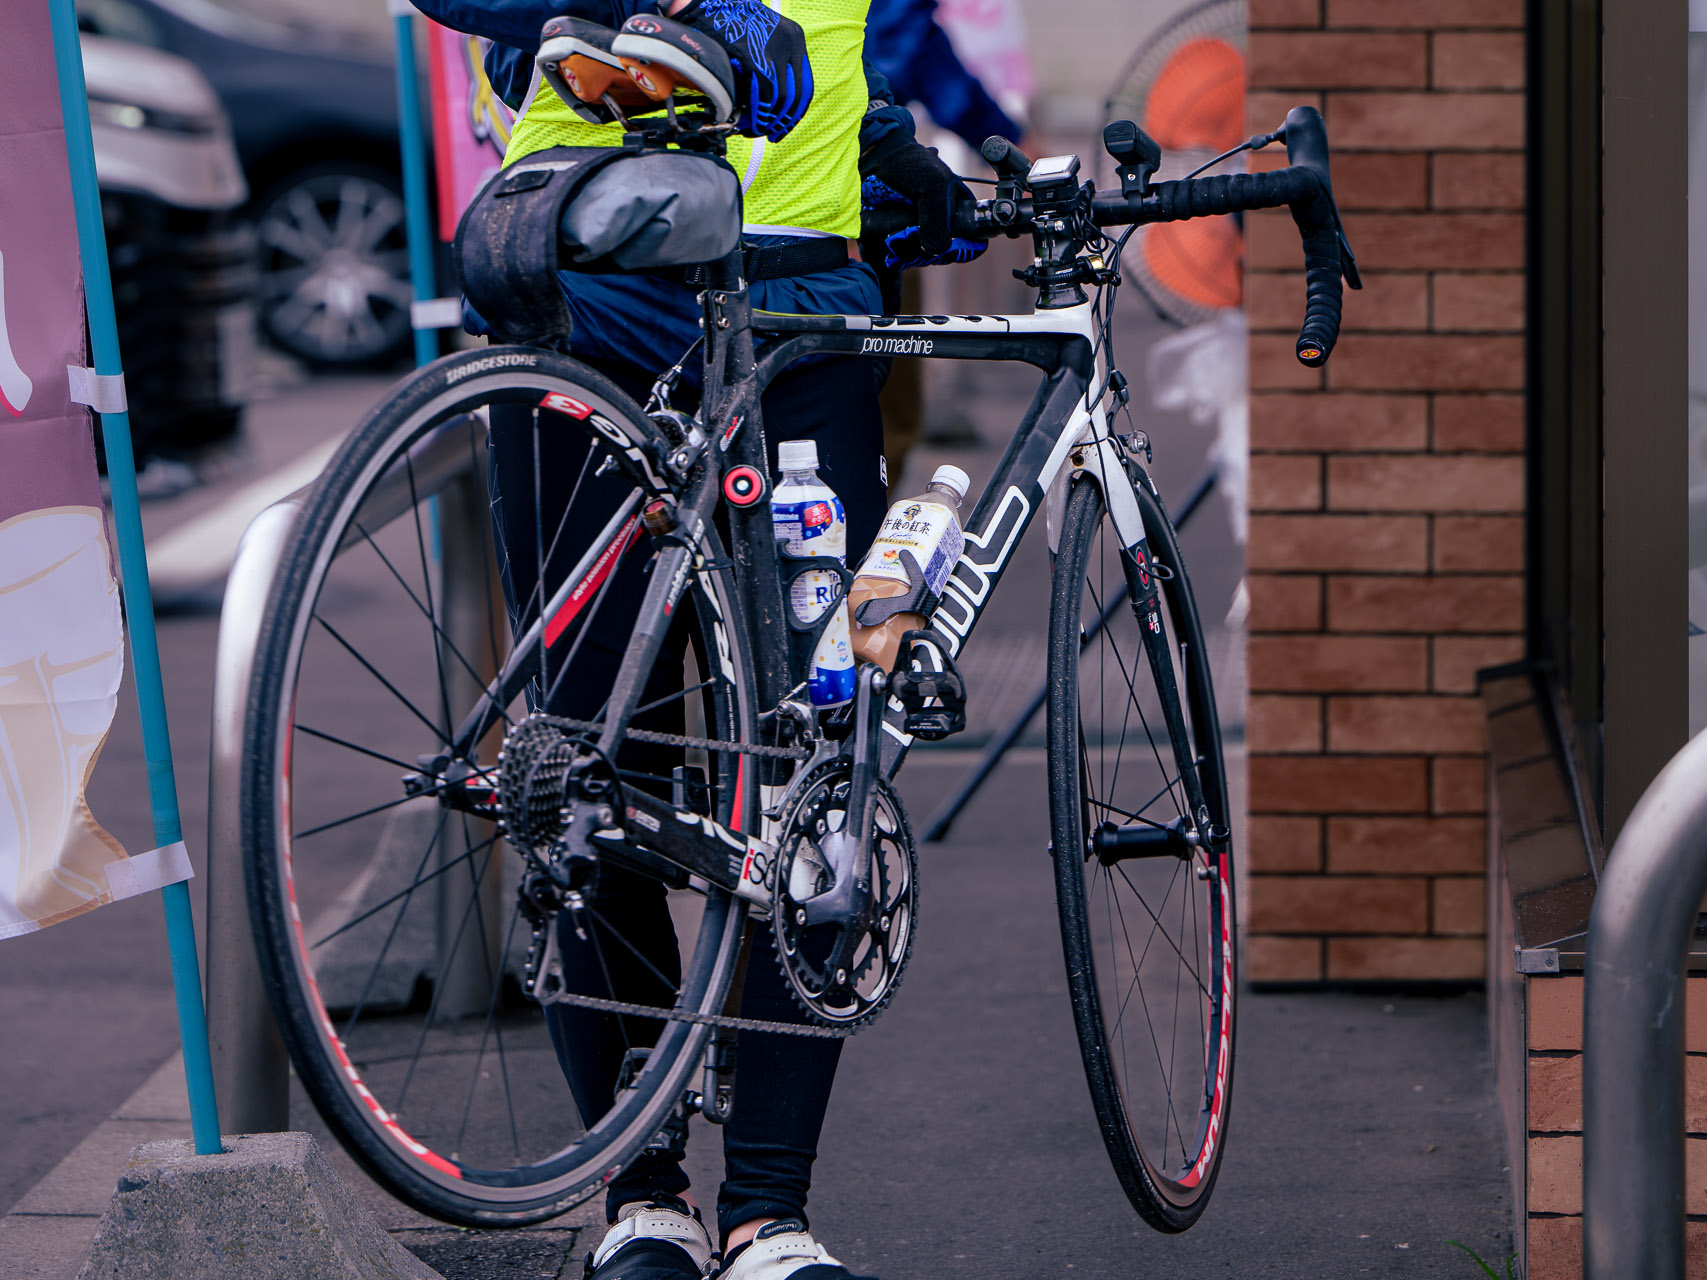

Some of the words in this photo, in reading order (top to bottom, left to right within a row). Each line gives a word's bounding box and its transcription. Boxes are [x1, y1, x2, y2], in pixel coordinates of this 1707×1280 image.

[860, 336, 883, 355] pro
[884, 335, 934, 355] machine
[883, 518, 932, 535] 午後の紅茶
